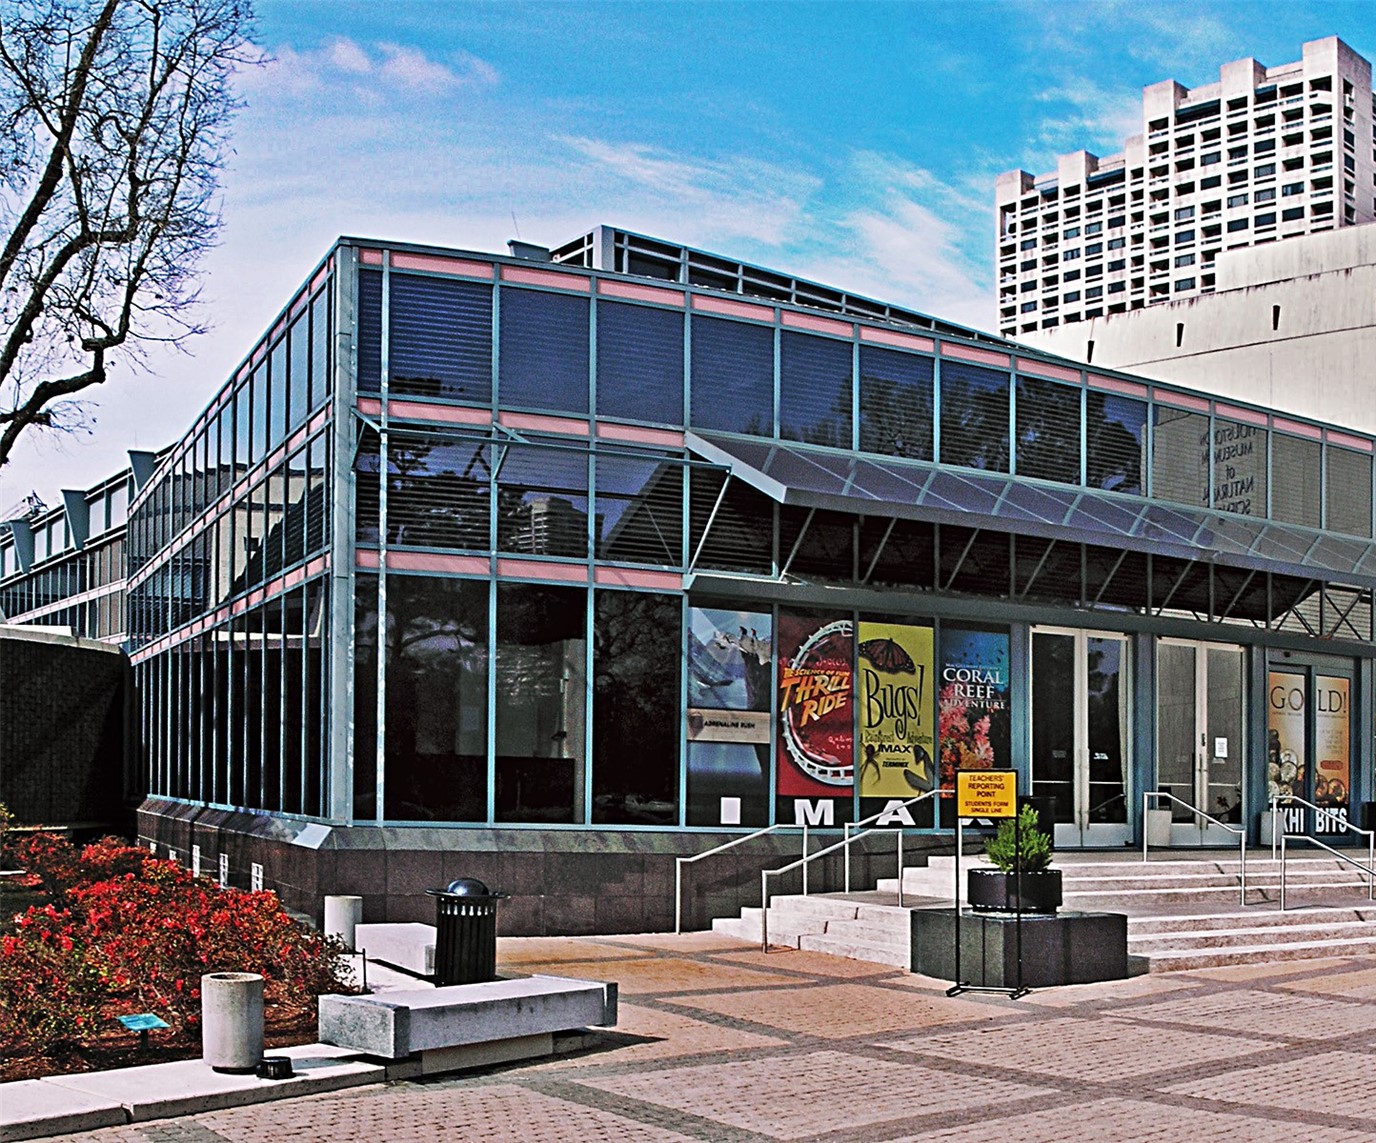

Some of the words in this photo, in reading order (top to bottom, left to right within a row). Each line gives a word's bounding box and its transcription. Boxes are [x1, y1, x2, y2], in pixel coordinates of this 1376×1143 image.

[943, 667, 1004, 684] CORAL
[780, 675, 850, 712] THRILL
[863, 664, 925, 740] Bugs!
[954, 682, 995, 699] REEF
[800, 691, 849, 727] RIDE
[944, 699, 1005, 710] ADVENTURE
